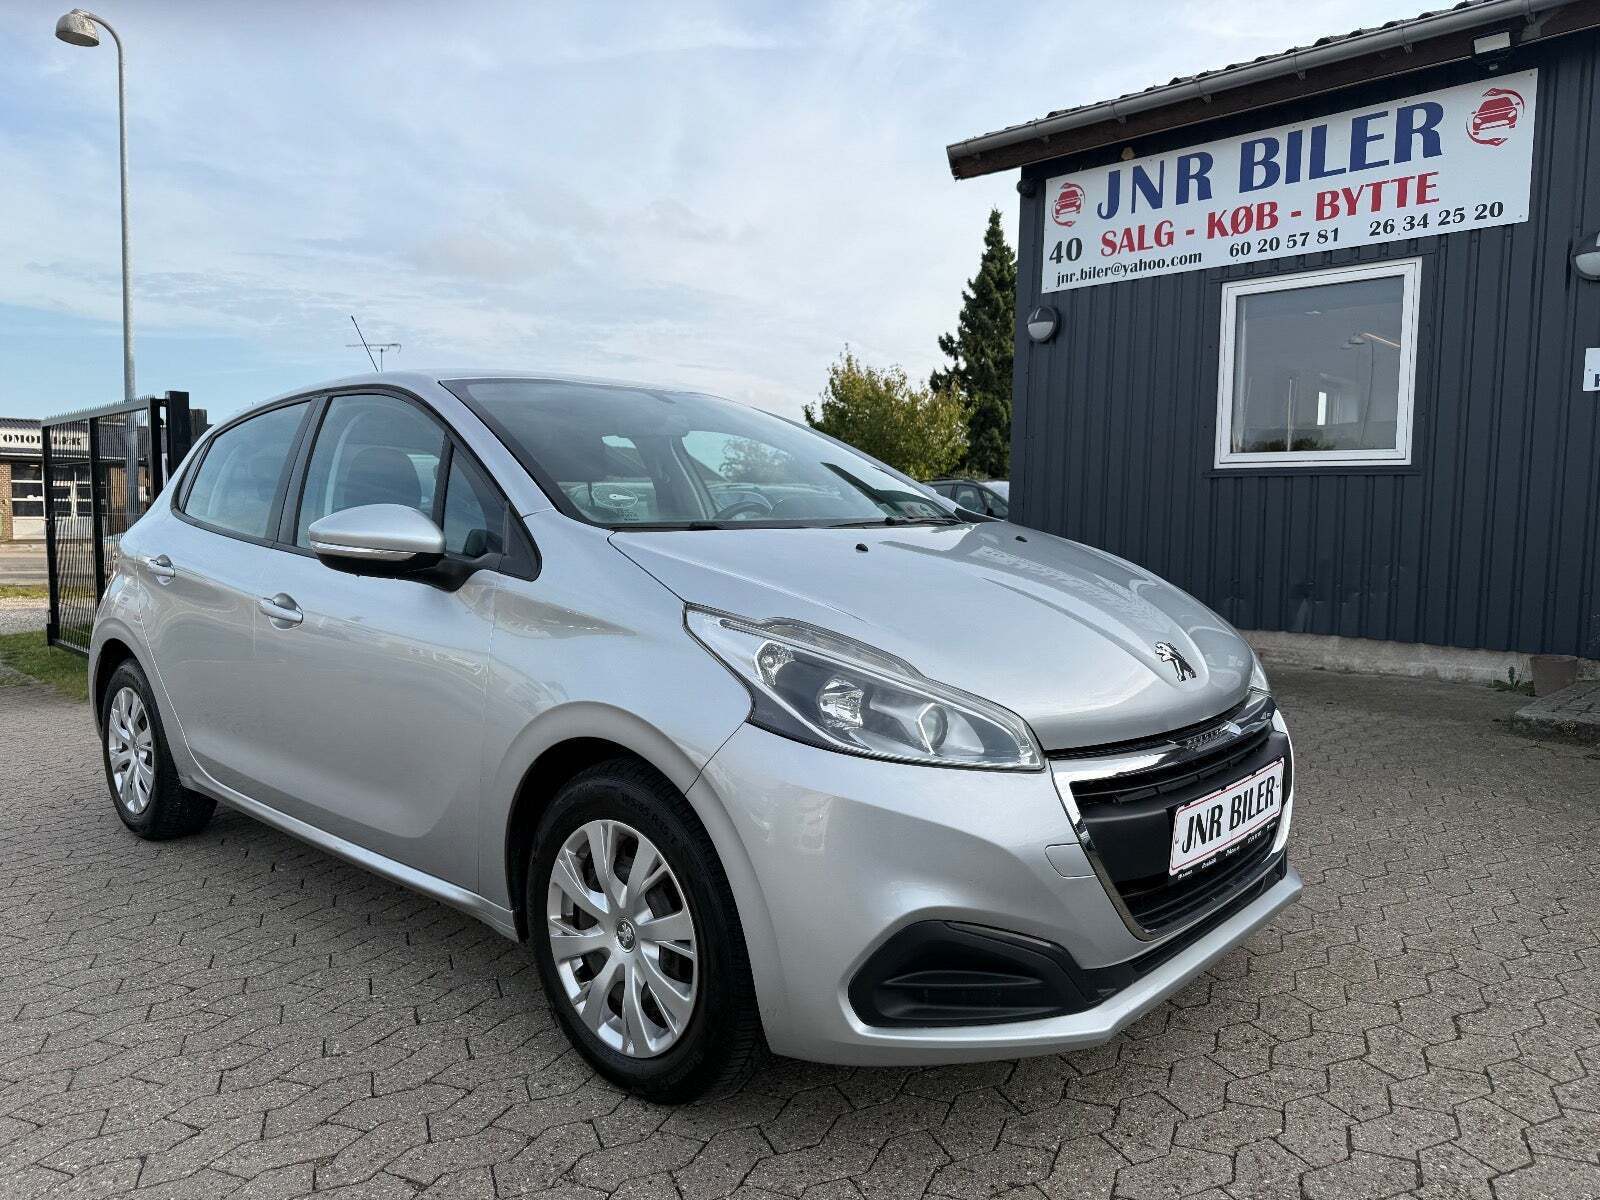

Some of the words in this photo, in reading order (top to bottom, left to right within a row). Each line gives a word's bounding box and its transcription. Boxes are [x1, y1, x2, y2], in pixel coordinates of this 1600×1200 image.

[1097, 151, 1213, 220] JNR
[1239, 101, 1444, 194] BILER
[1100, 220, 1175, 257] SALG
[1206, 201, 1279, 240] KØB
[1315, 171, 1440, 222] BYTTE
[1369, 218, 1395, 237] 26
[1402, 212, 1430, 232] 34
[1437, 207, 1466, 226] 25
[1474, 201, 1504, 221] 20
[1049, 237, 1083, 264] 40
[1229, 242, 1251, 258] 60
[1257, 236, 1280, 253] 20
[1286, 231, 1310, 249] 57
[1317, 227, 1340, 245] 81
[1056, 251, 1203, 288] jnr.biler@yahoo.com
[1181, 803, 1224, 854] JNR
[1229, 775, 1276, 832] BILER
